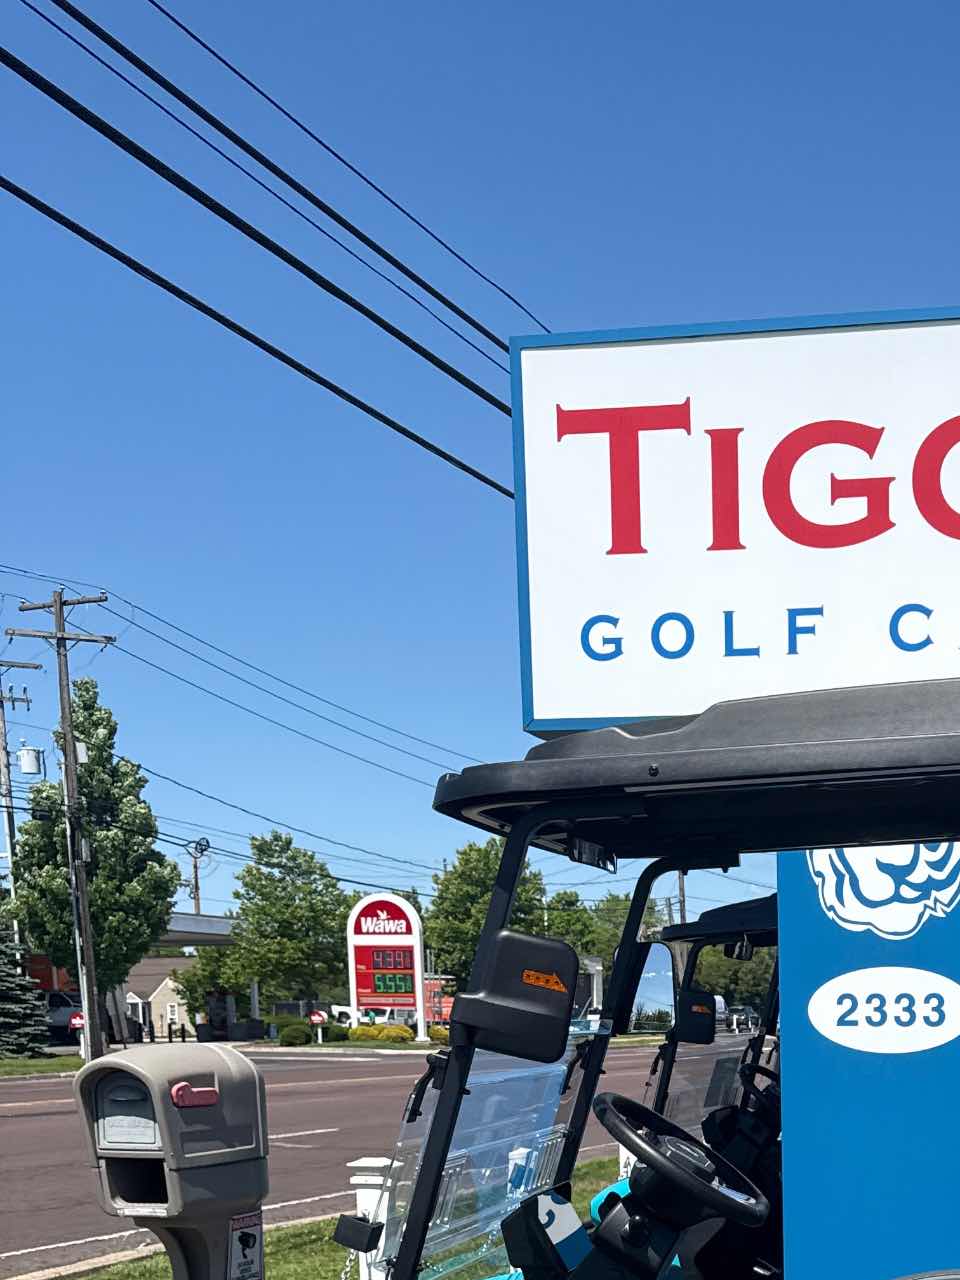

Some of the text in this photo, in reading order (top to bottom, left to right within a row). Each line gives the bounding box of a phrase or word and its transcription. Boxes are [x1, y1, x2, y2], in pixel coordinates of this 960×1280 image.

[581, 608, 823, 661] GOLF
[361, 916, 407, 934] Wawa
[836, 993, 946, 1027] 2333
